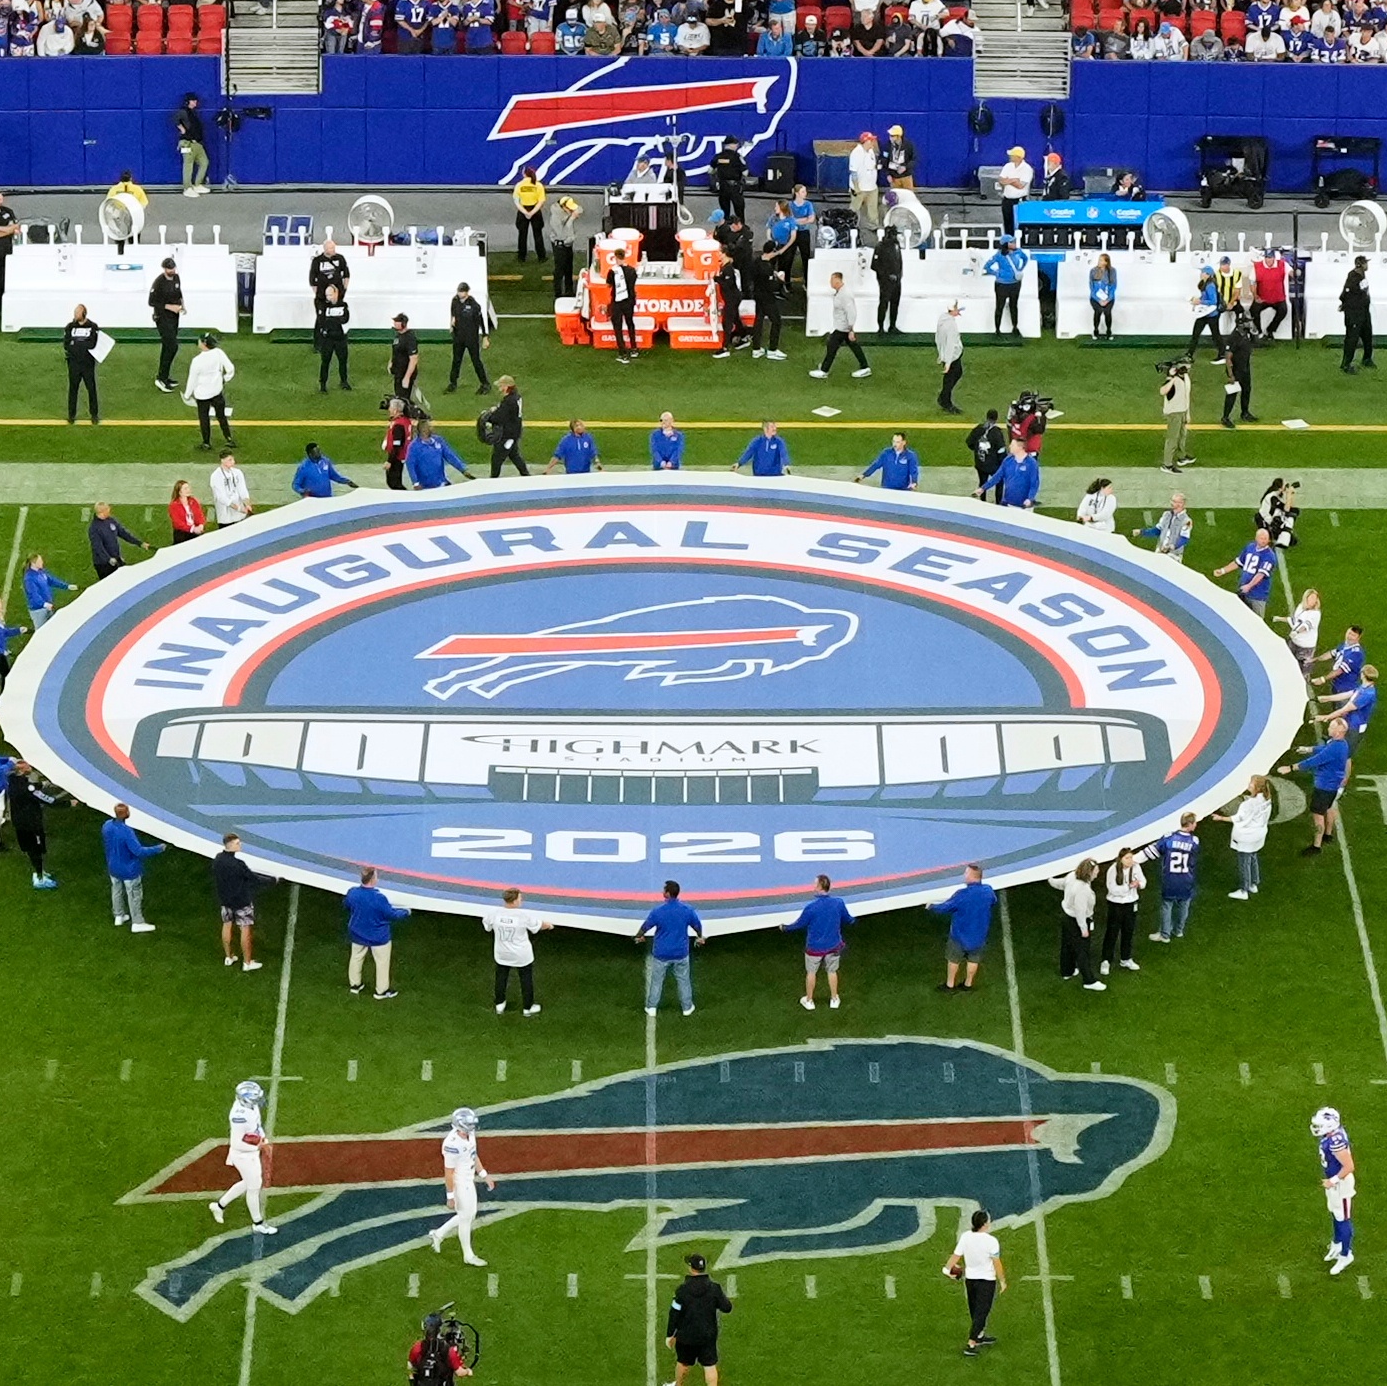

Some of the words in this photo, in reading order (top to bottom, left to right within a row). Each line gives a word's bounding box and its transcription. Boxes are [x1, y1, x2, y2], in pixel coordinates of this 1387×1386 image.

[700, 253, 712, 265] G
[634, 299, 704, 313] TORADE
[1243, 552, 1260, 574] 12
[135, 520, 748, 691] INAUGURAL
[807, 531, 1176, 692] SEASON
[502, 738, 821, 756] HIGHMARK
[431, 827, 875, 865] 2026
[1170, 852, 1189, 873] 21
[498, 927, 516, 942] 17
